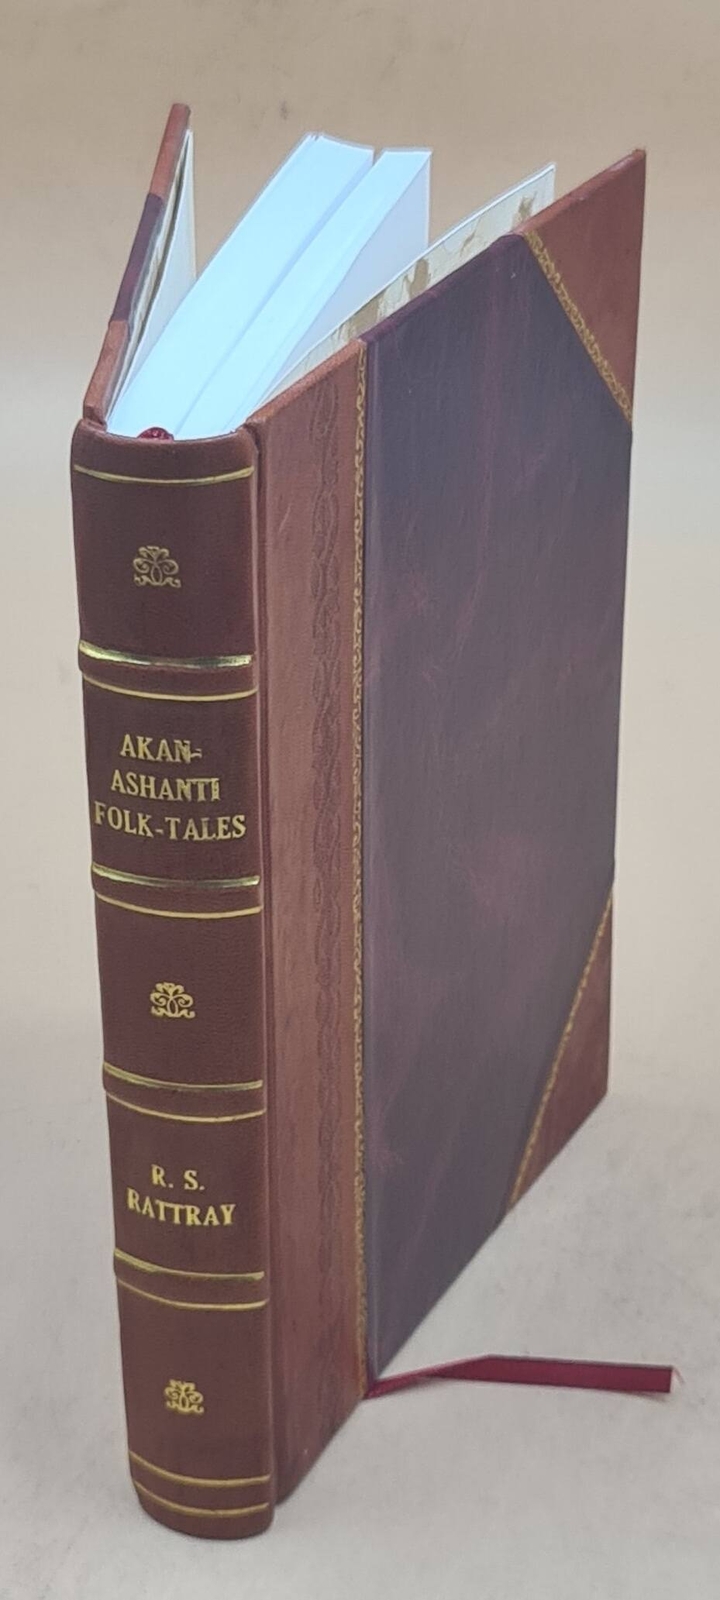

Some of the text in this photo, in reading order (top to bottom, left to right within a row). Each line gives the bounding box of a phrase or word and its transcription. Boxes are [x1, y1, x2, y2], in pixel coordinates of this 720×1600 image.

[119, 733, 203, 764] AKAN-
[110, 769, 221, 802] ASHANTI
[93, 800, 247, 841] FOLK-TALES
[151, 1163, 206, 1191] R. S.
[126, 1187, 236, 1226] RATTRAY
